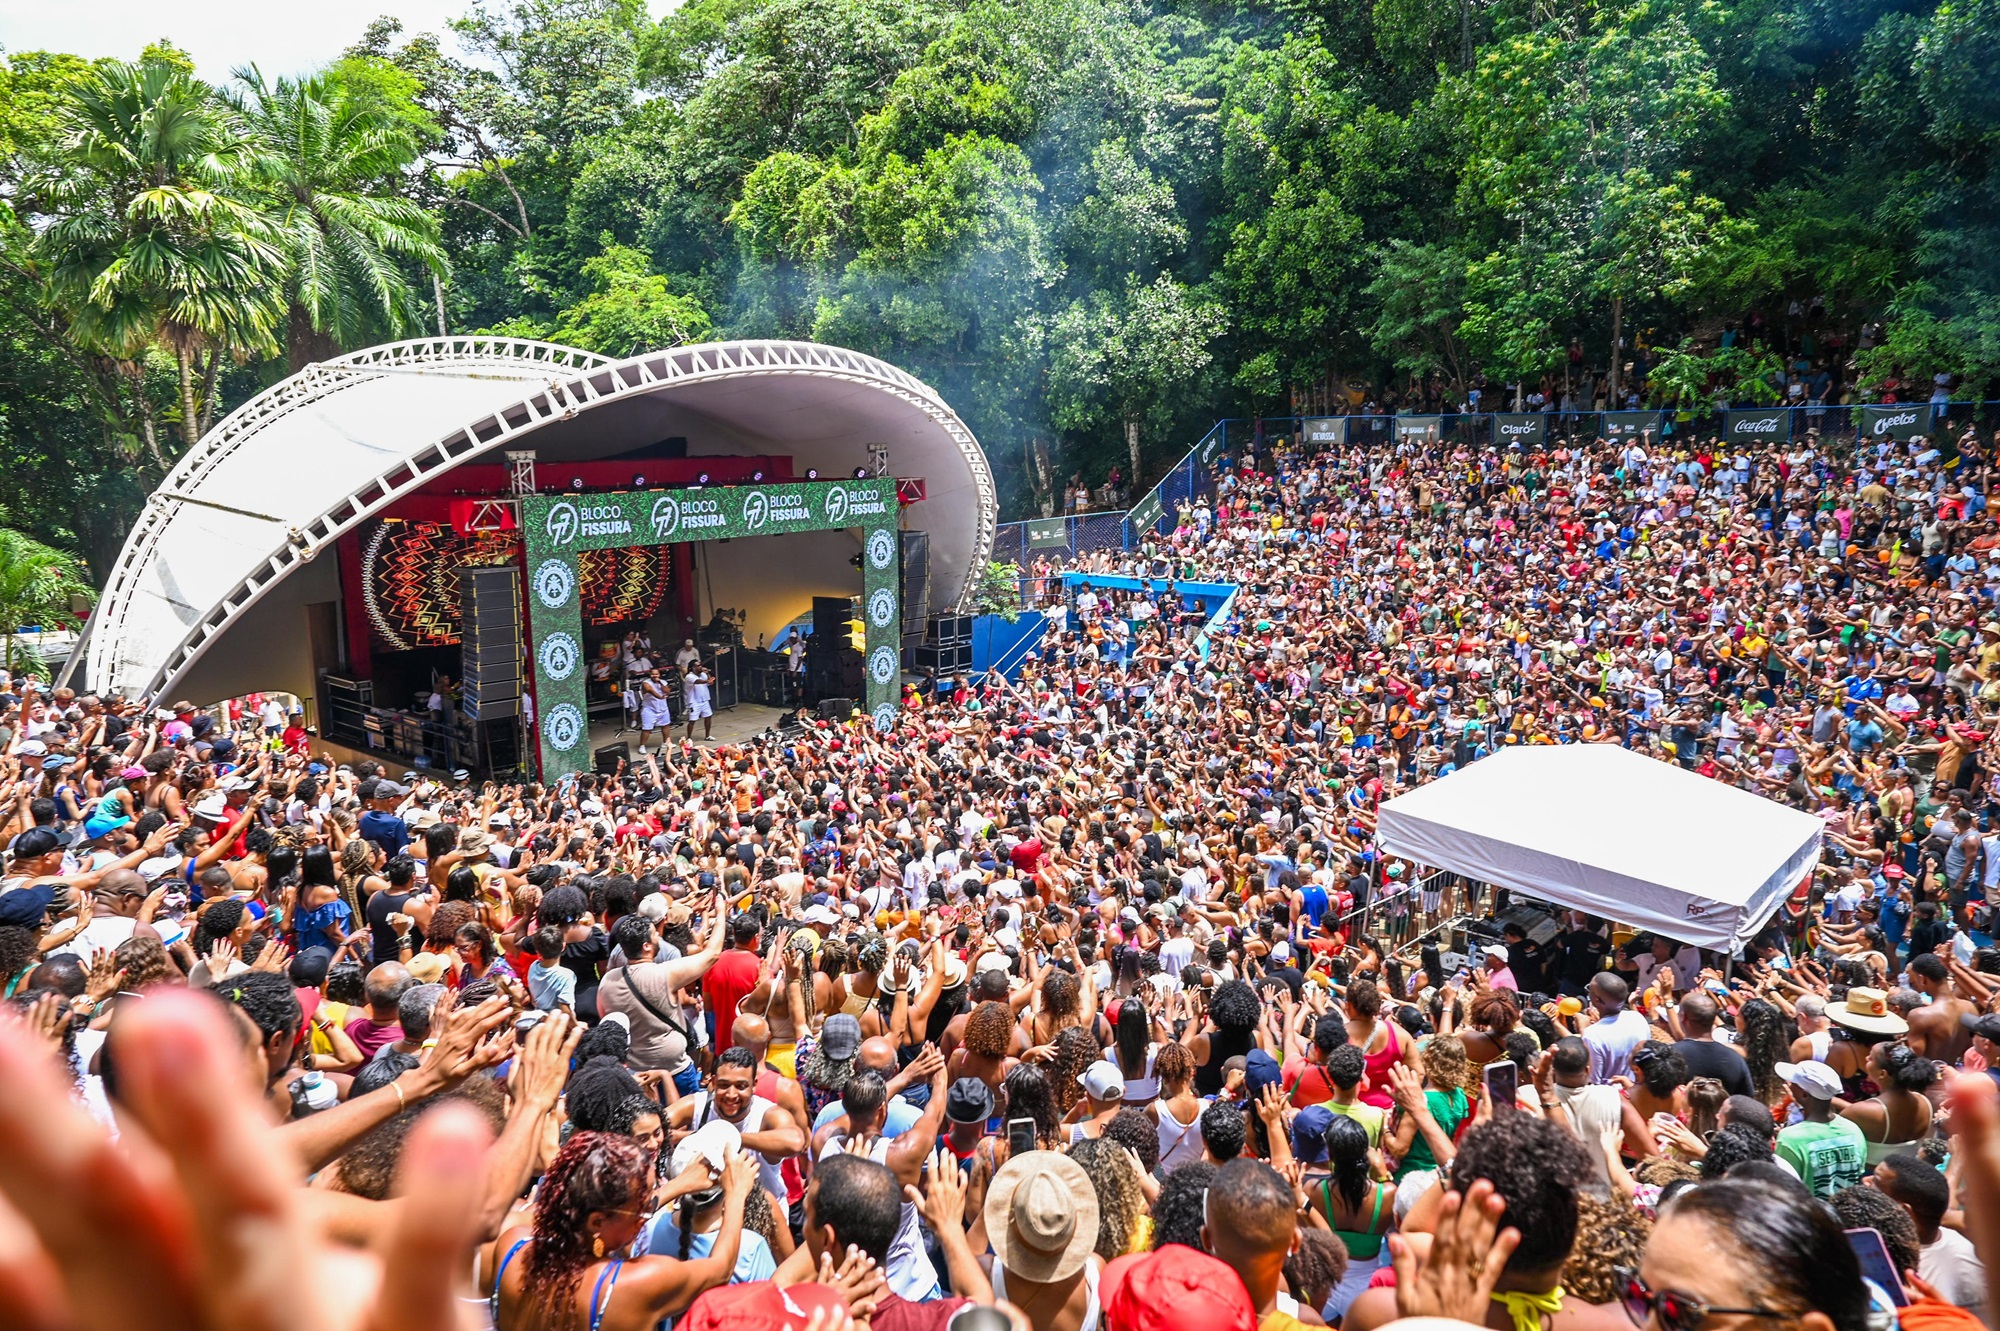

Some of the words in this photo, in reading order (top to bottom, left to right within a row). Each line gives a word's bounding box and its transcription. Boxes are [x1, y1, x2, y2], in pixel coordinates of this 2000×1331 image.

[1500, 423, 1531, 434] Claro
[1873, 412, 1917, 435] Cheetos
[770, 494, 802, 508] BLOCO
[850, 489, 879, 502] BLOCO
[581, 505, 622, 520] BLOCO
[681, 500, 717, 514] BLOCO
[850, 502, 886, 515] FISSURA
[681, 514, 726, 529] FISSURA
[770, 508, 811, 522] FISSURA
[581, 520, 632, 537] FISSURA
[1686, 903, 1705, 916] RP
